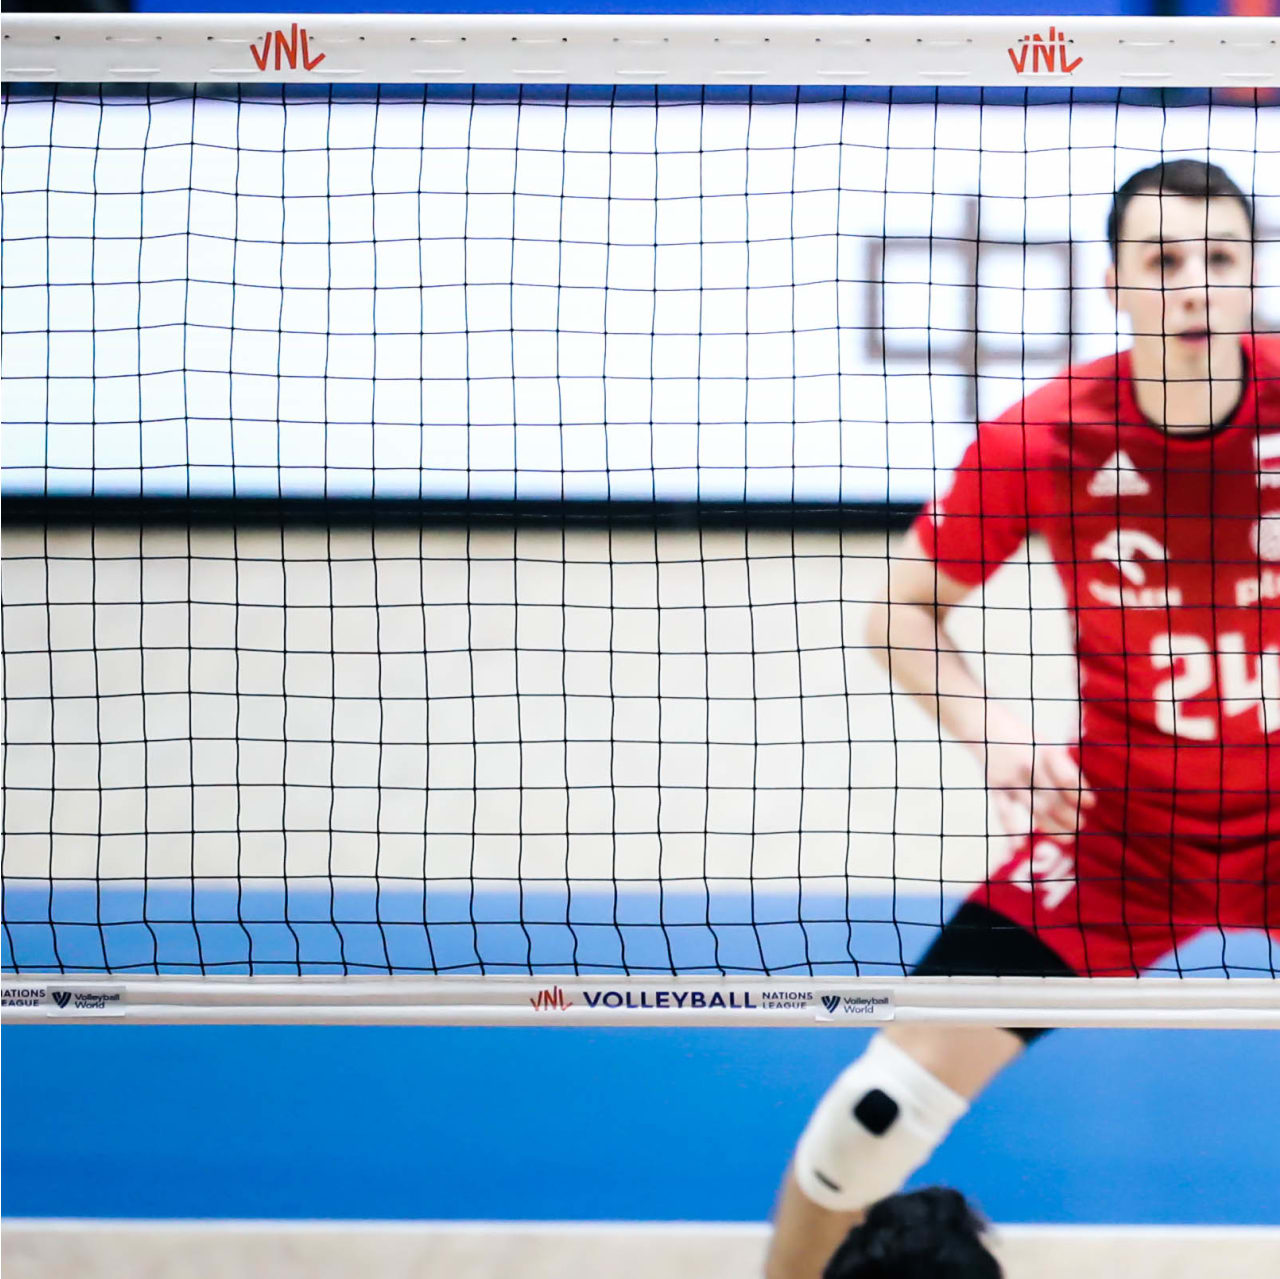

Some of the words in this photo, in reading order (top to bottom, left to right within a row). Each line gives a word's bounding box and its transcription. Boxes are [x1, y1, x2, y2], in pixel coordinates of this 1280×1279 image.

[249, 23, 326, 71] VNL
[1007, 26, 1083, 73] VNL
[74, 993, 120, 1002] Volleyball
[530, 985, 574, 1011] VNL
[582, 991, 758, 1009] VOLLEYBALL
[762, 991, 813, 1000] NATIONS
[74, 1001, 105, 1009] World
[762, 1001, 807, 1010] LEAGUE
[843, 997, 889, 1006] Volleyball
[844, 1005, 874, 1014] World
